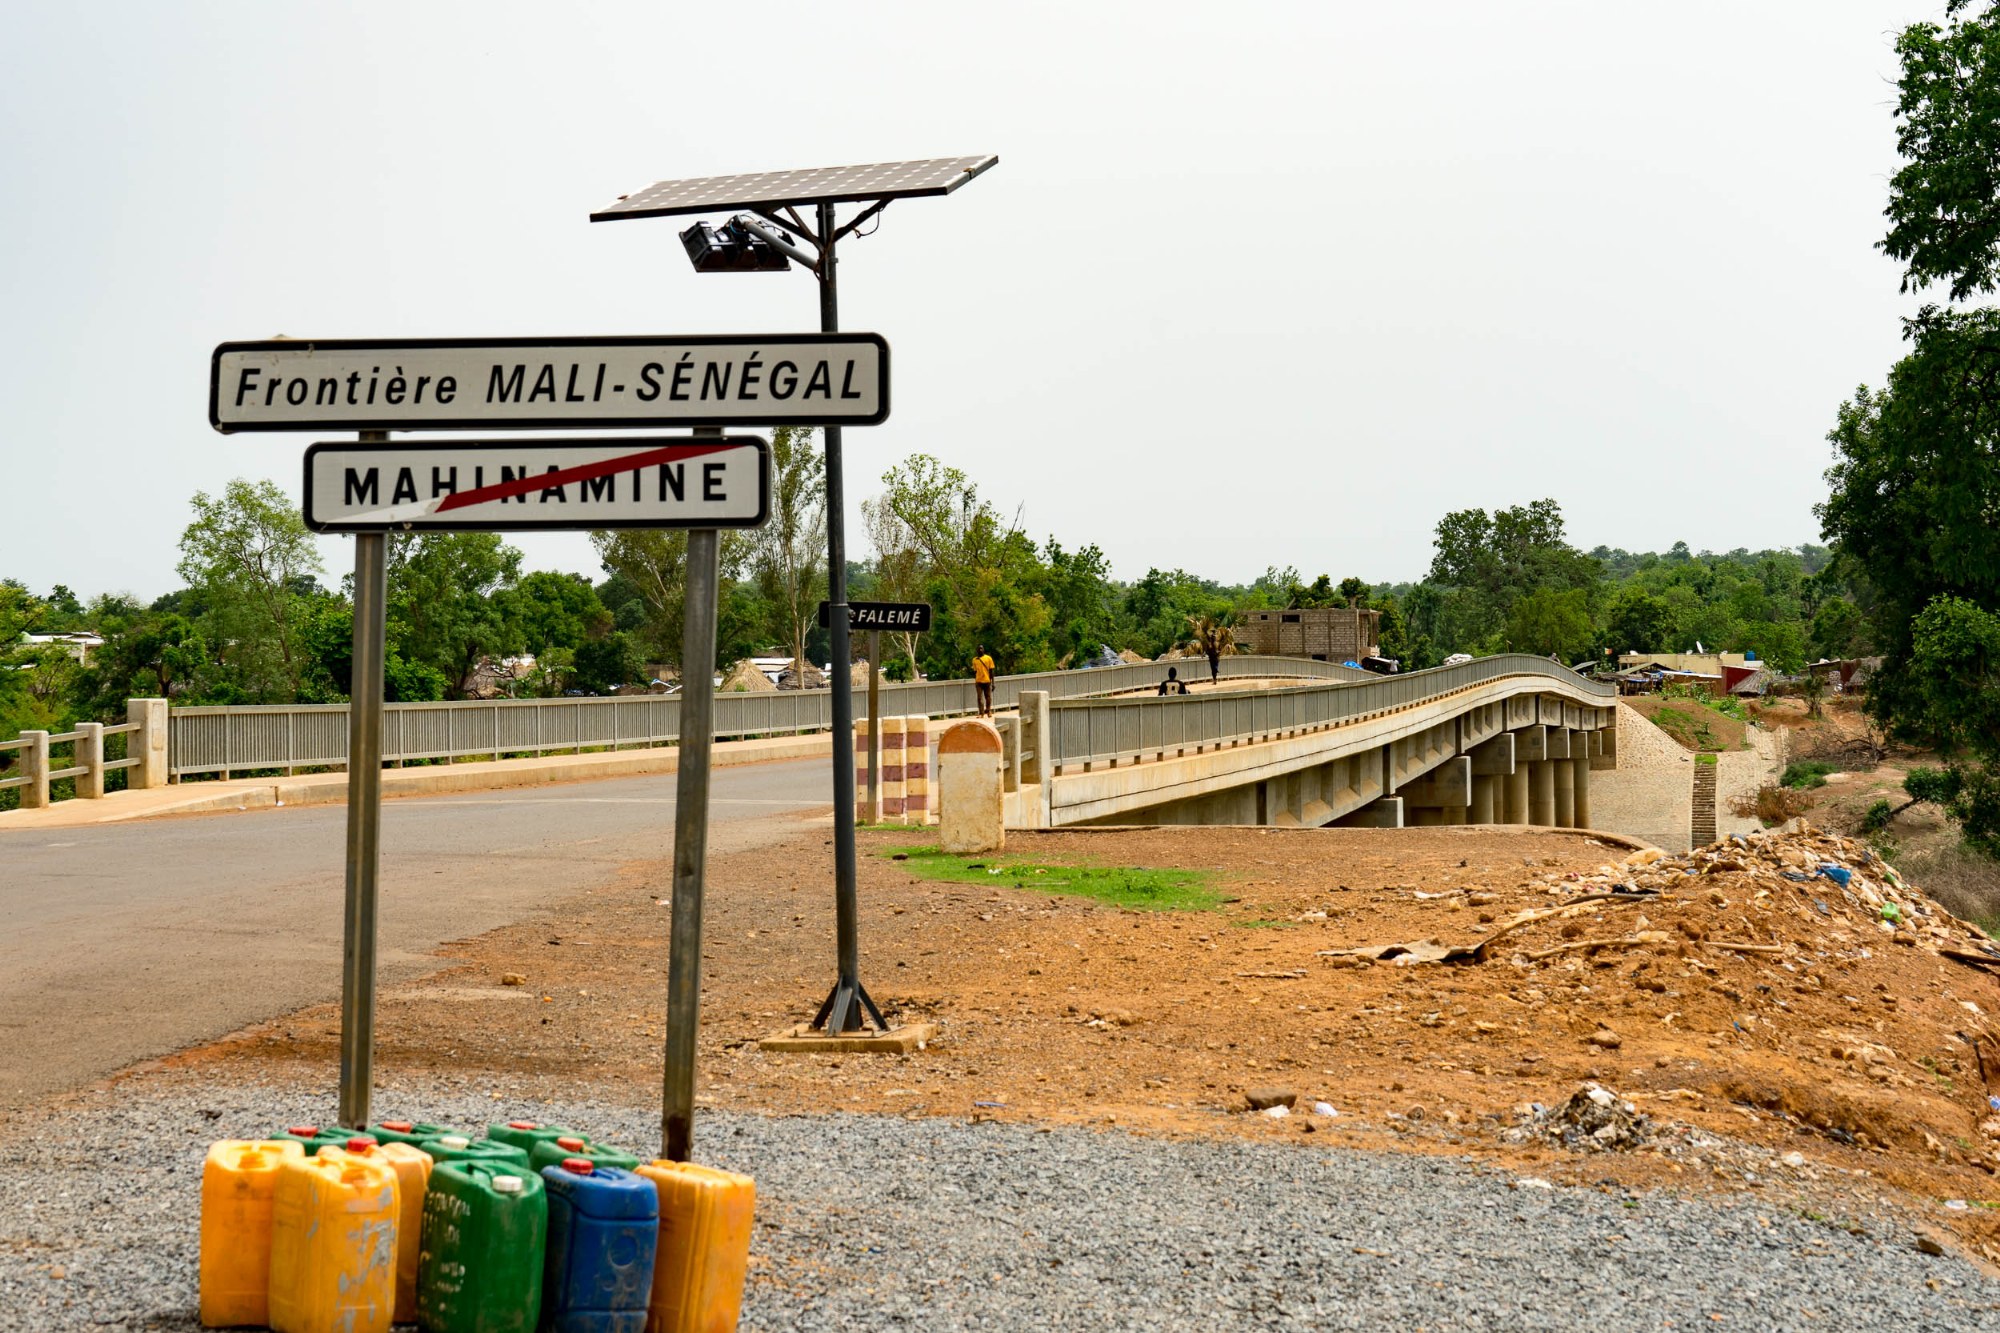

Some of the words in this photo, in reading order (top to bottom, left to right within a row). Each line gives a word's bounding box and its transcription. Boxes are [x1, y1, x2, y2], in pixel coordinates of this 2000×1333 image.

[235, 366, 457, 406] Frontière
[486, 351, 861, 404] MALI-SÉNÉGAL
[344, 462, 727, 506] MAHINAMINE
[857, 608, 921, 625] FALEMÉ
